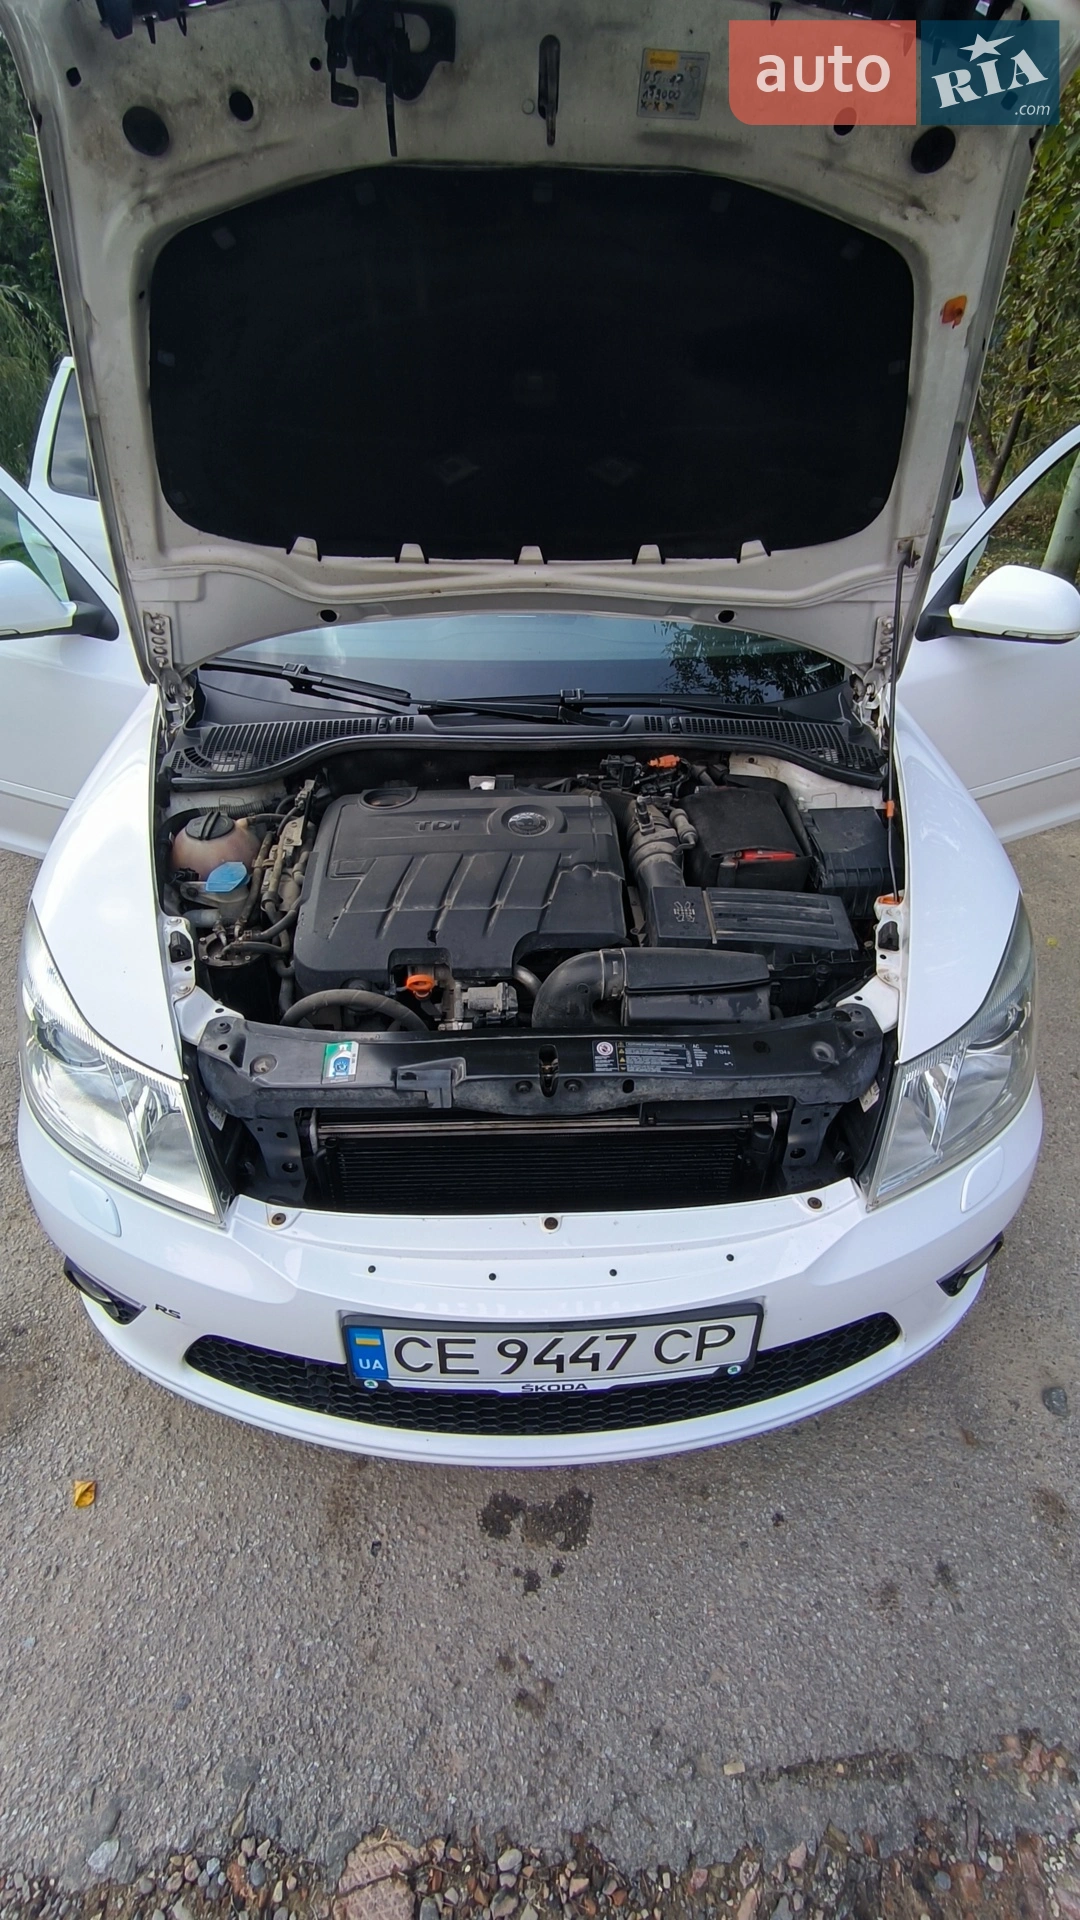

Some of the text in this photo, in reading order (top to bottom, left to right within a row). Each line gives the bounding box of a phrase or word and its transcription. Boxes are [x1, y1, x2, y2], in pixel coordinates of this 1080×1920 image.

[415, 820, 461, 831] TDI
[155, 1303, 181, 1320] RS
[394, 1324, 736, 1375] CE 9447 CP
[359, 1358, 384, 1371] UA
[521, 1382, 588, 1393] ŠKODA
